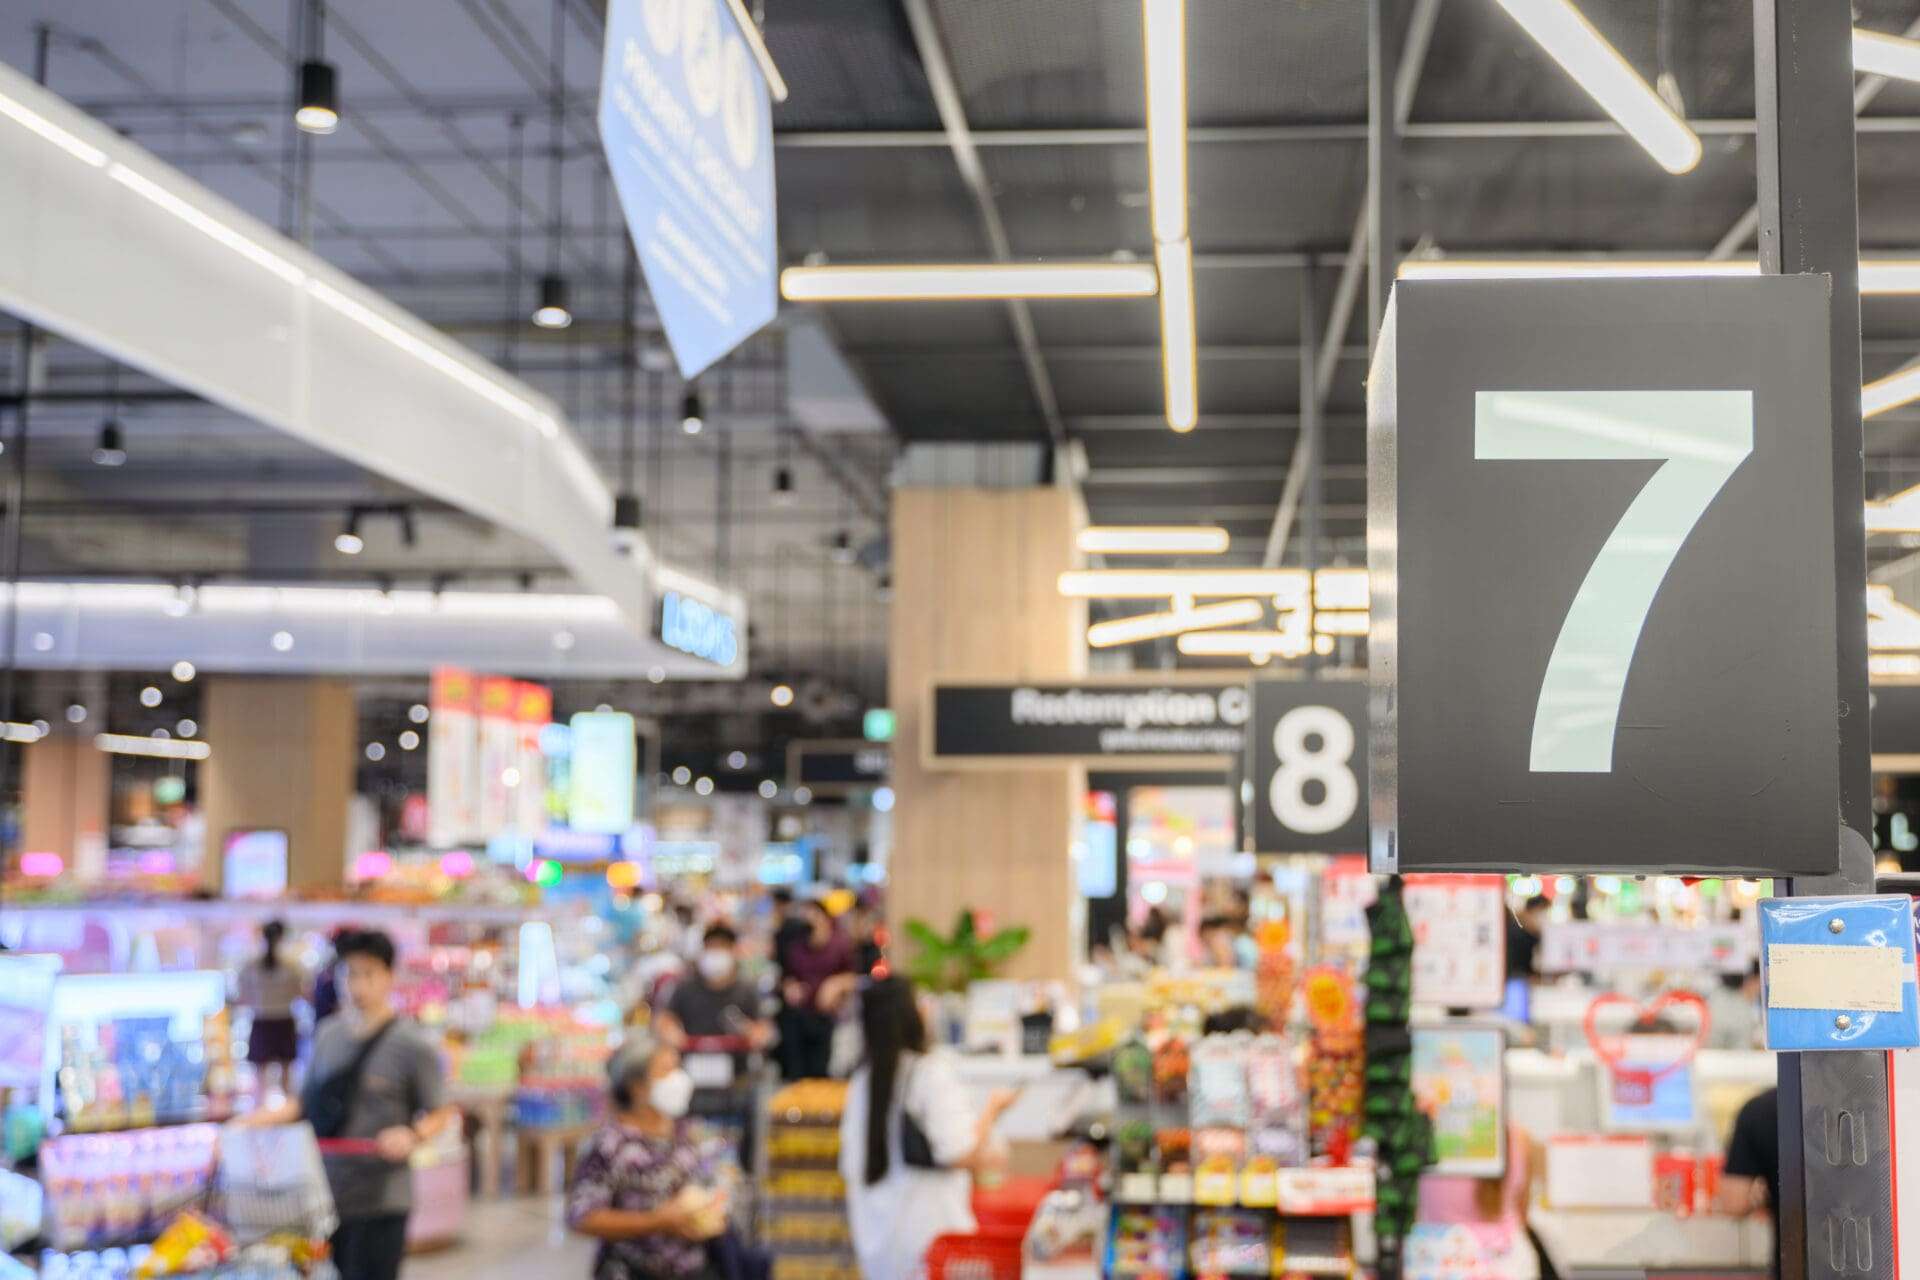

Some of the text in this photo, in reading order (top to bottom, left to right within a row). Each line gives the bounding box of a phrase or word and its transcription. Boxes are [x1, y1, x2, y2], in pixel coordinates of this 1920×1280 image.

[1474, 390, 1754, 772] 7
[1011, 687, 1216, 728] Redemption
[1269, 704, 1359, 834] 8
